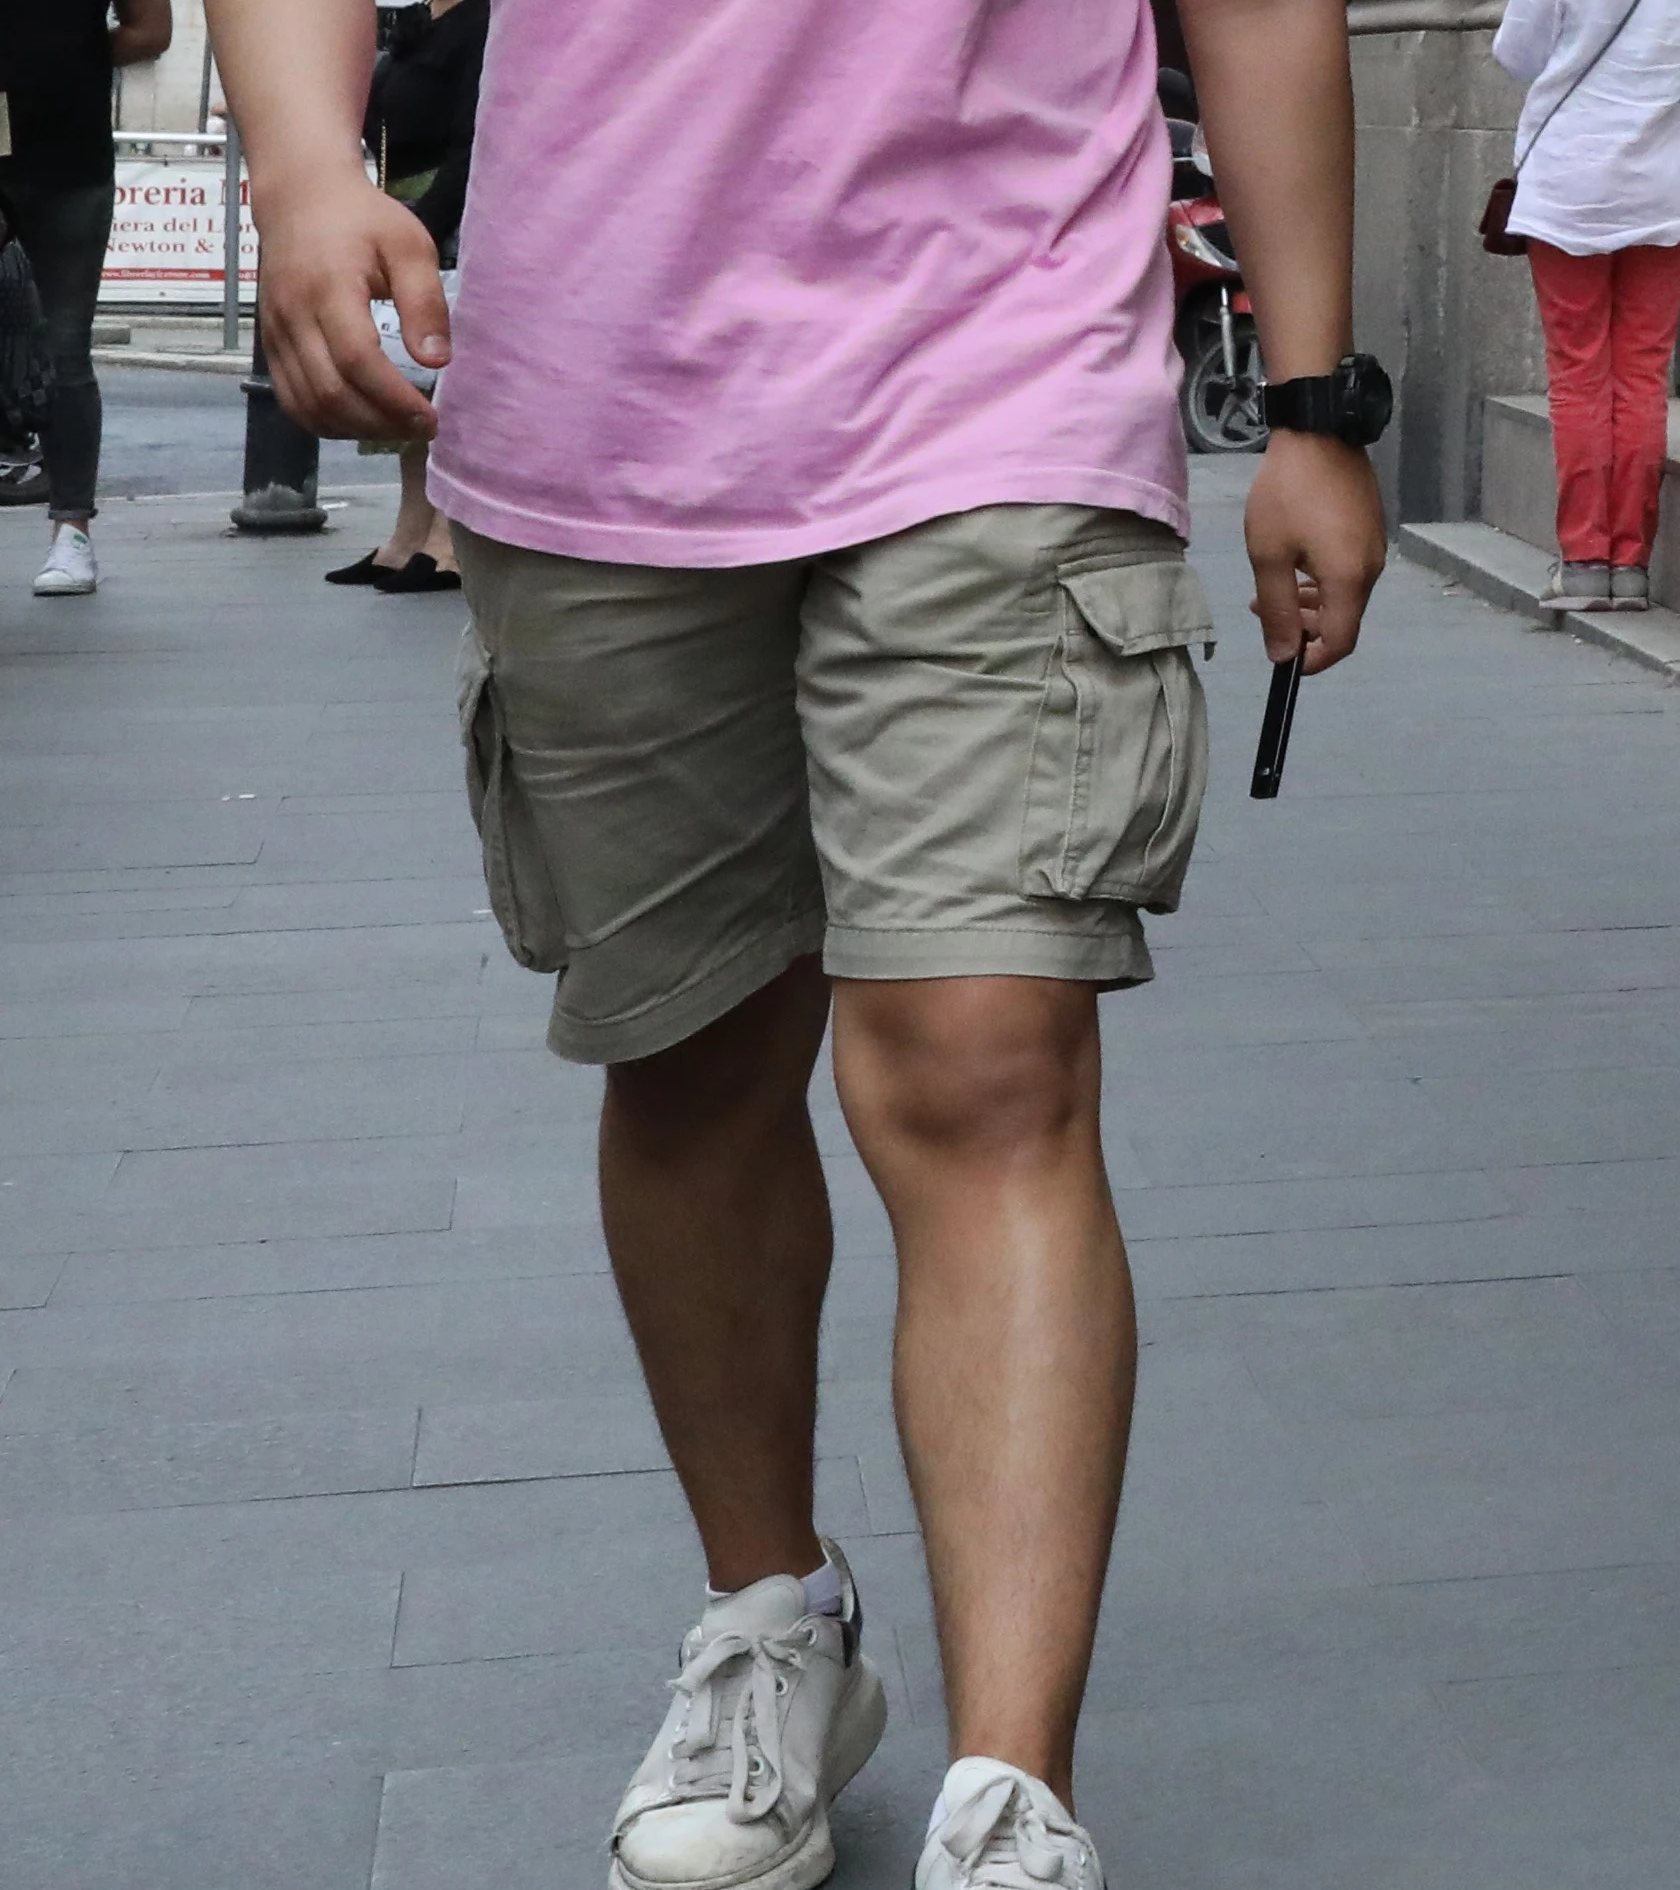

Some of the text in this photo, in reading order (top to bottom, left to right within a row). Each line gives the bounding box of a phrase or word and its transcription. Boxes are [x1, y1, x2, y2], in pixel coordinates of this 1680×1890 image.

[112, 217, 155, 233] iera
[163, 217, 197, 233] del
[106, 238, 185, 254] Newton
